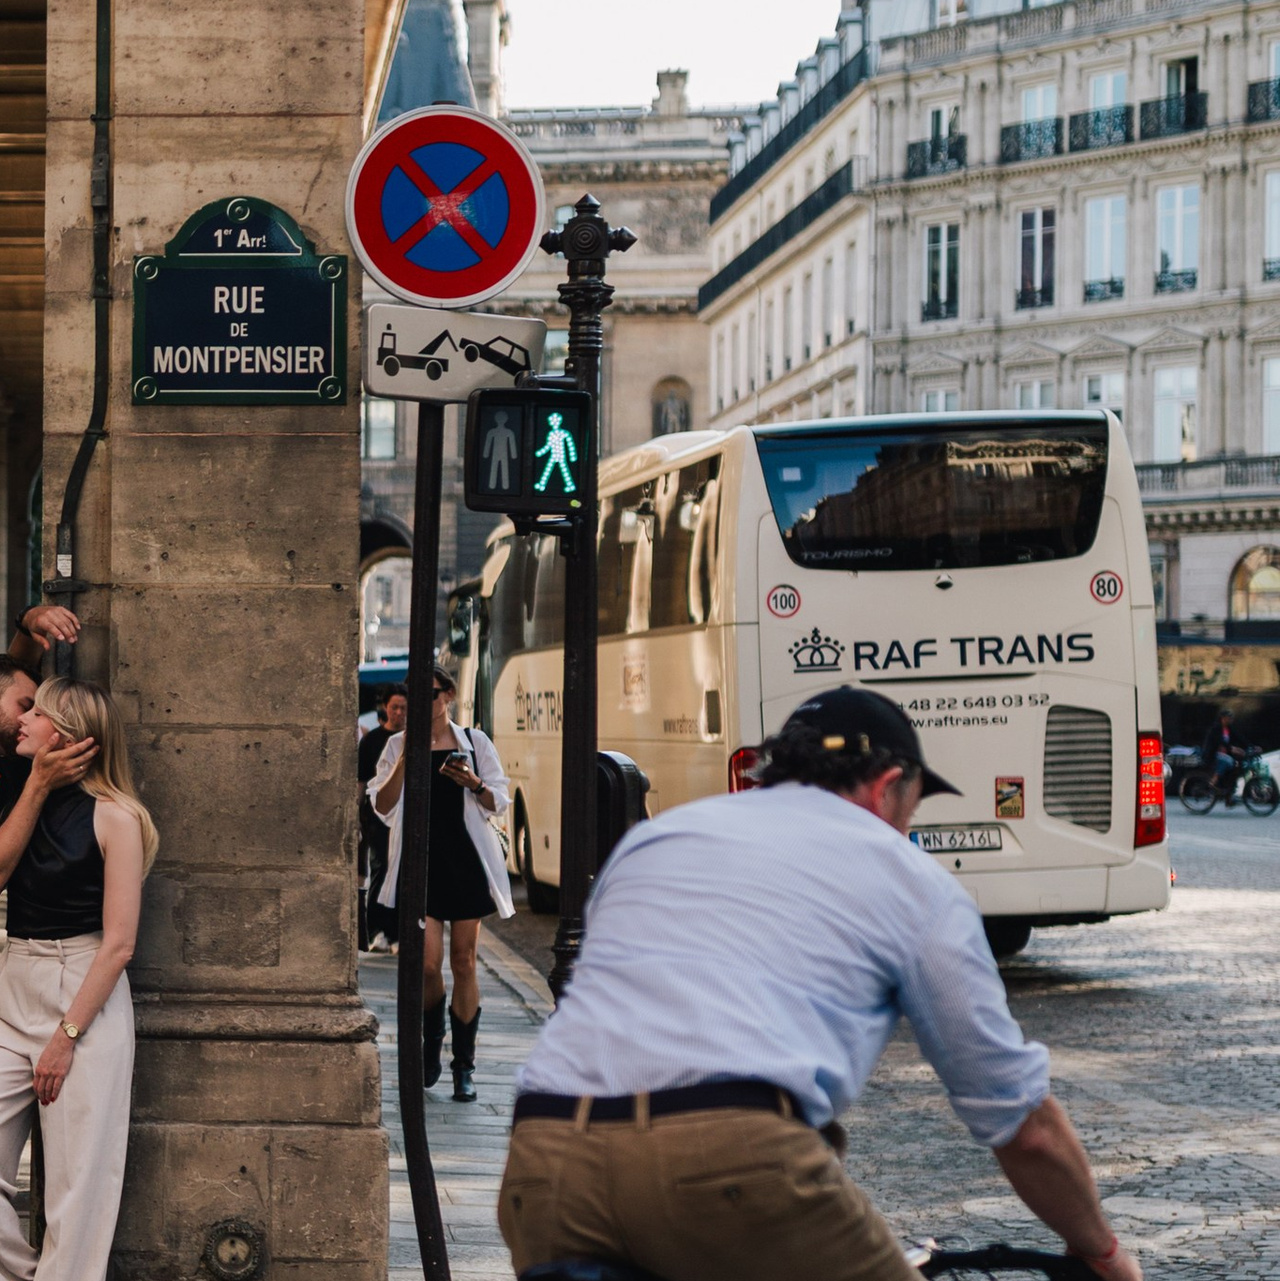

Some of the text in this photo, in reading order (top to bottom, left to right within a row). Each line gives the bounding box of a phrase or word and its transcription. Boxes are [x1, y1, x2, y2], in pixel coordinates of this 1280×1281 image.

[213, 286, 265, 314] RUE
[230, 322, 248, 338] DE
[153, 345, 325, 374] MONTPENSIER
[801, 547, 893, 561] TOURISMO
[1096, 578, 1118, 597] 80
[771, 591, 797, 611] 100
[853, 632, 1096, 672] RAF TRANS
[525, 690, 564, 732] RAF TRA
[936, 696, 958, 711] 22
[963, 695, 997, 710] 648
[1002, 694, 1024, 708] 03
[1028, 693, 1050, 706] 52
[921, 829, 997, 849] WN 6216L
